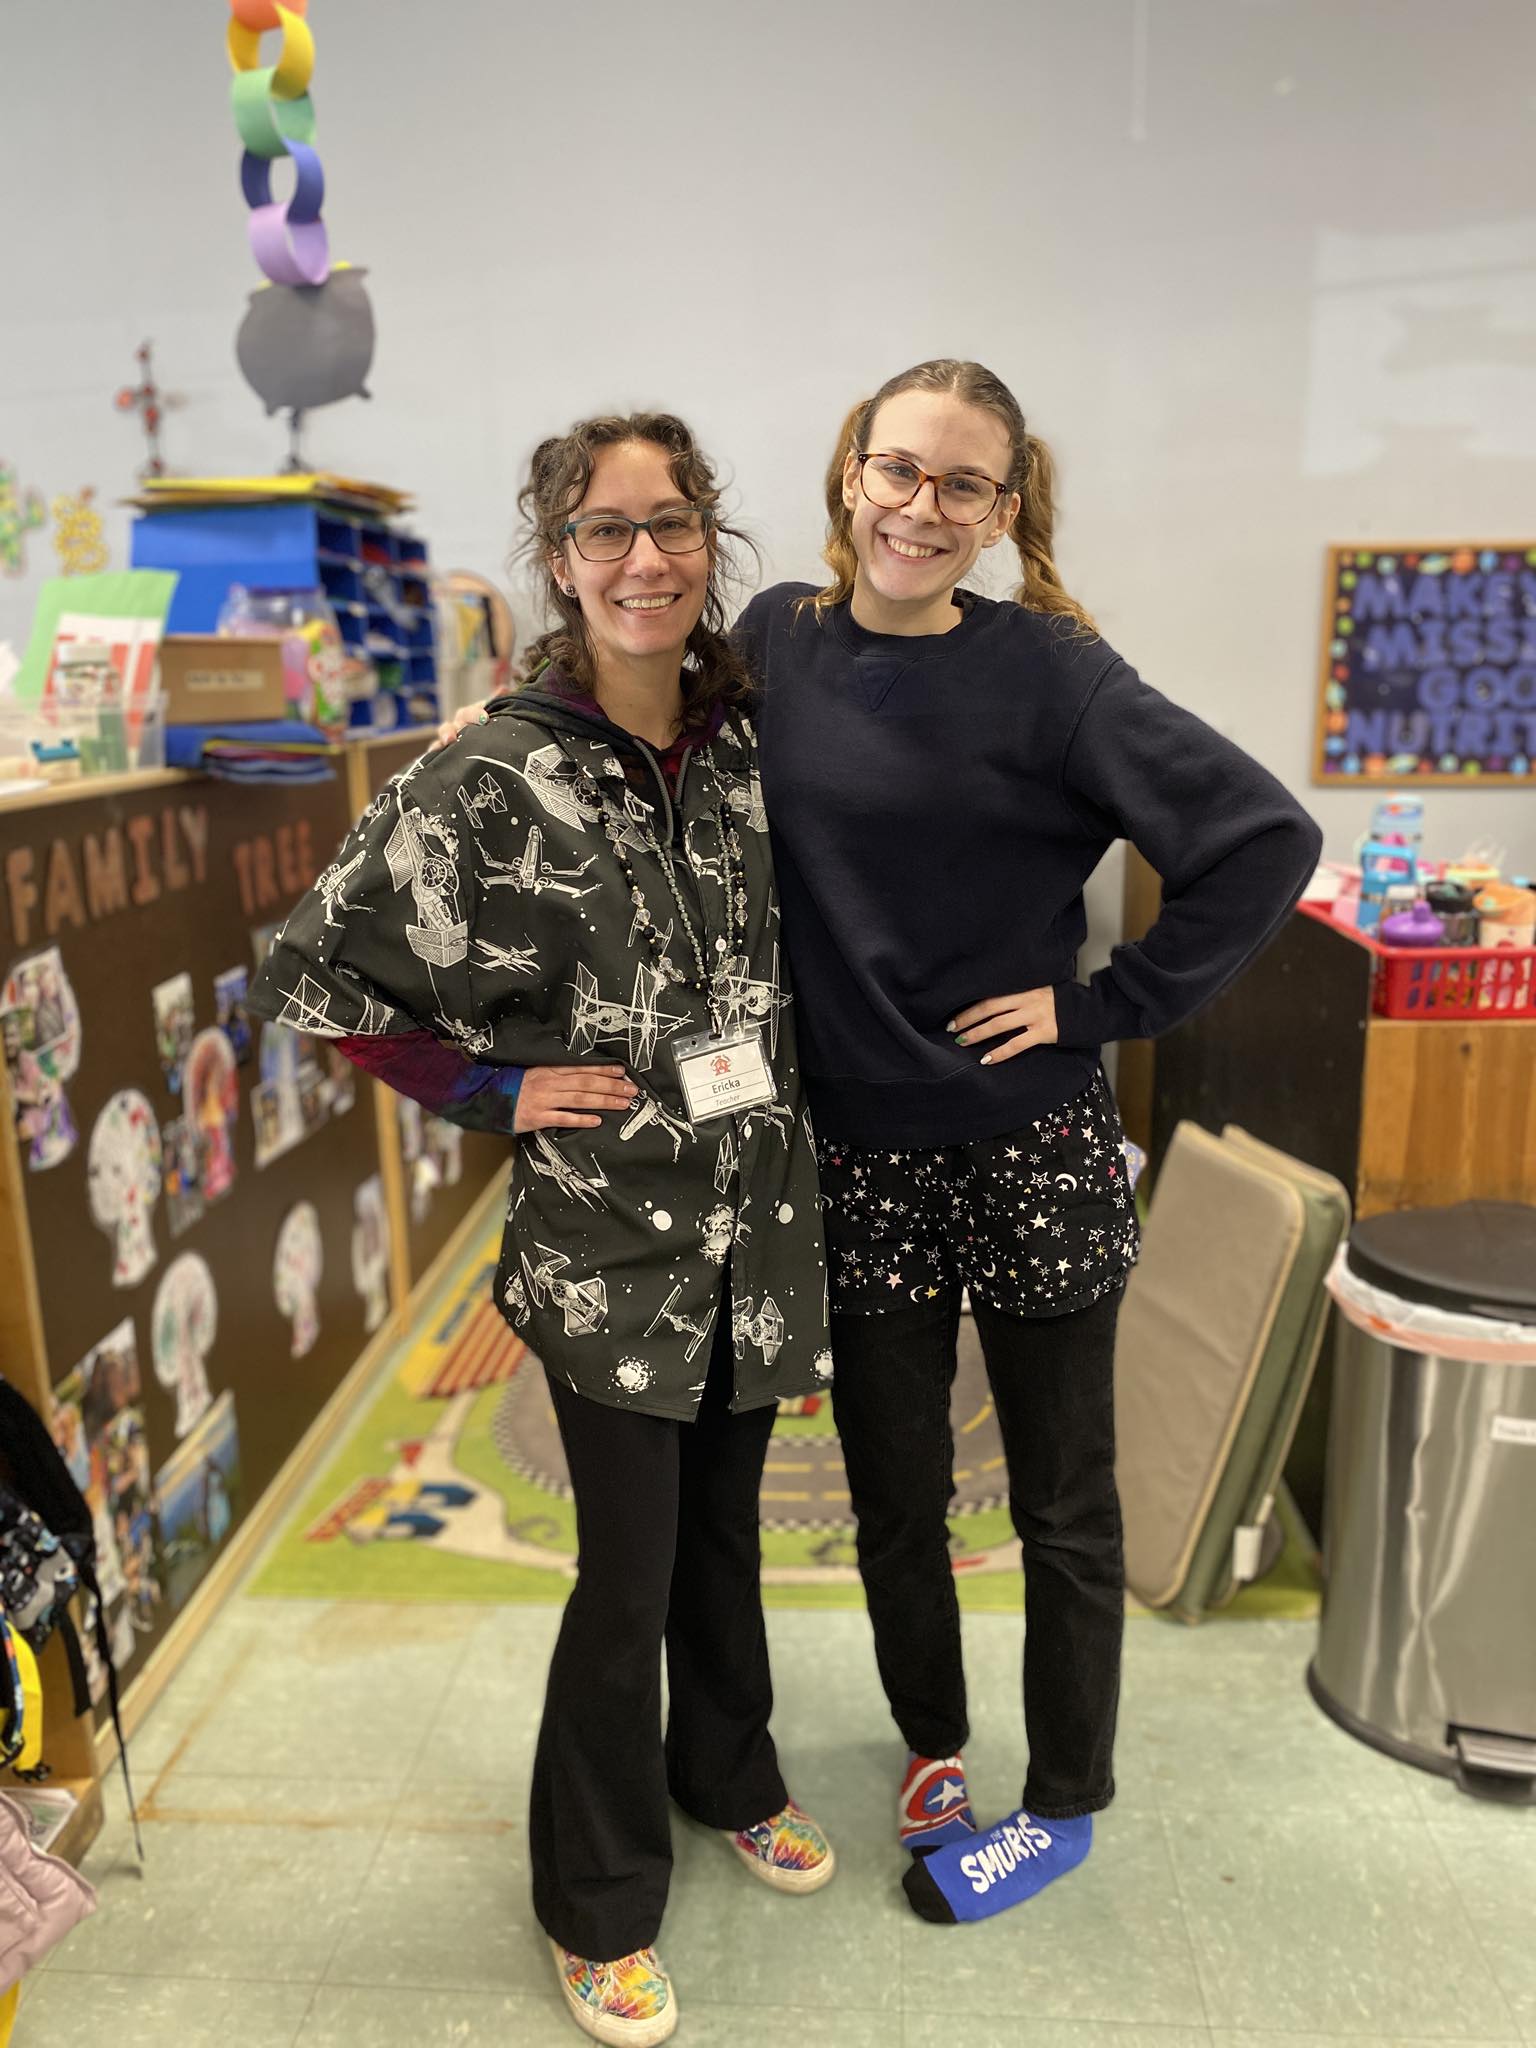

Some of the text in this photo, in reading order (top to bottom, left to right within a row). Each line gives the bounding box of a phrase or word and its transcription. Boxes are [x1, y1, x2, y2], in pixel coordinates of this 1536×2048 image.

[1353, 572, 1514, 619] MAKE
[5, 805, 314, 946] FAMILY TREE
[711, 1079, 741, 1094] Ericka
[715, 1094, 741, 1107] Teacher
